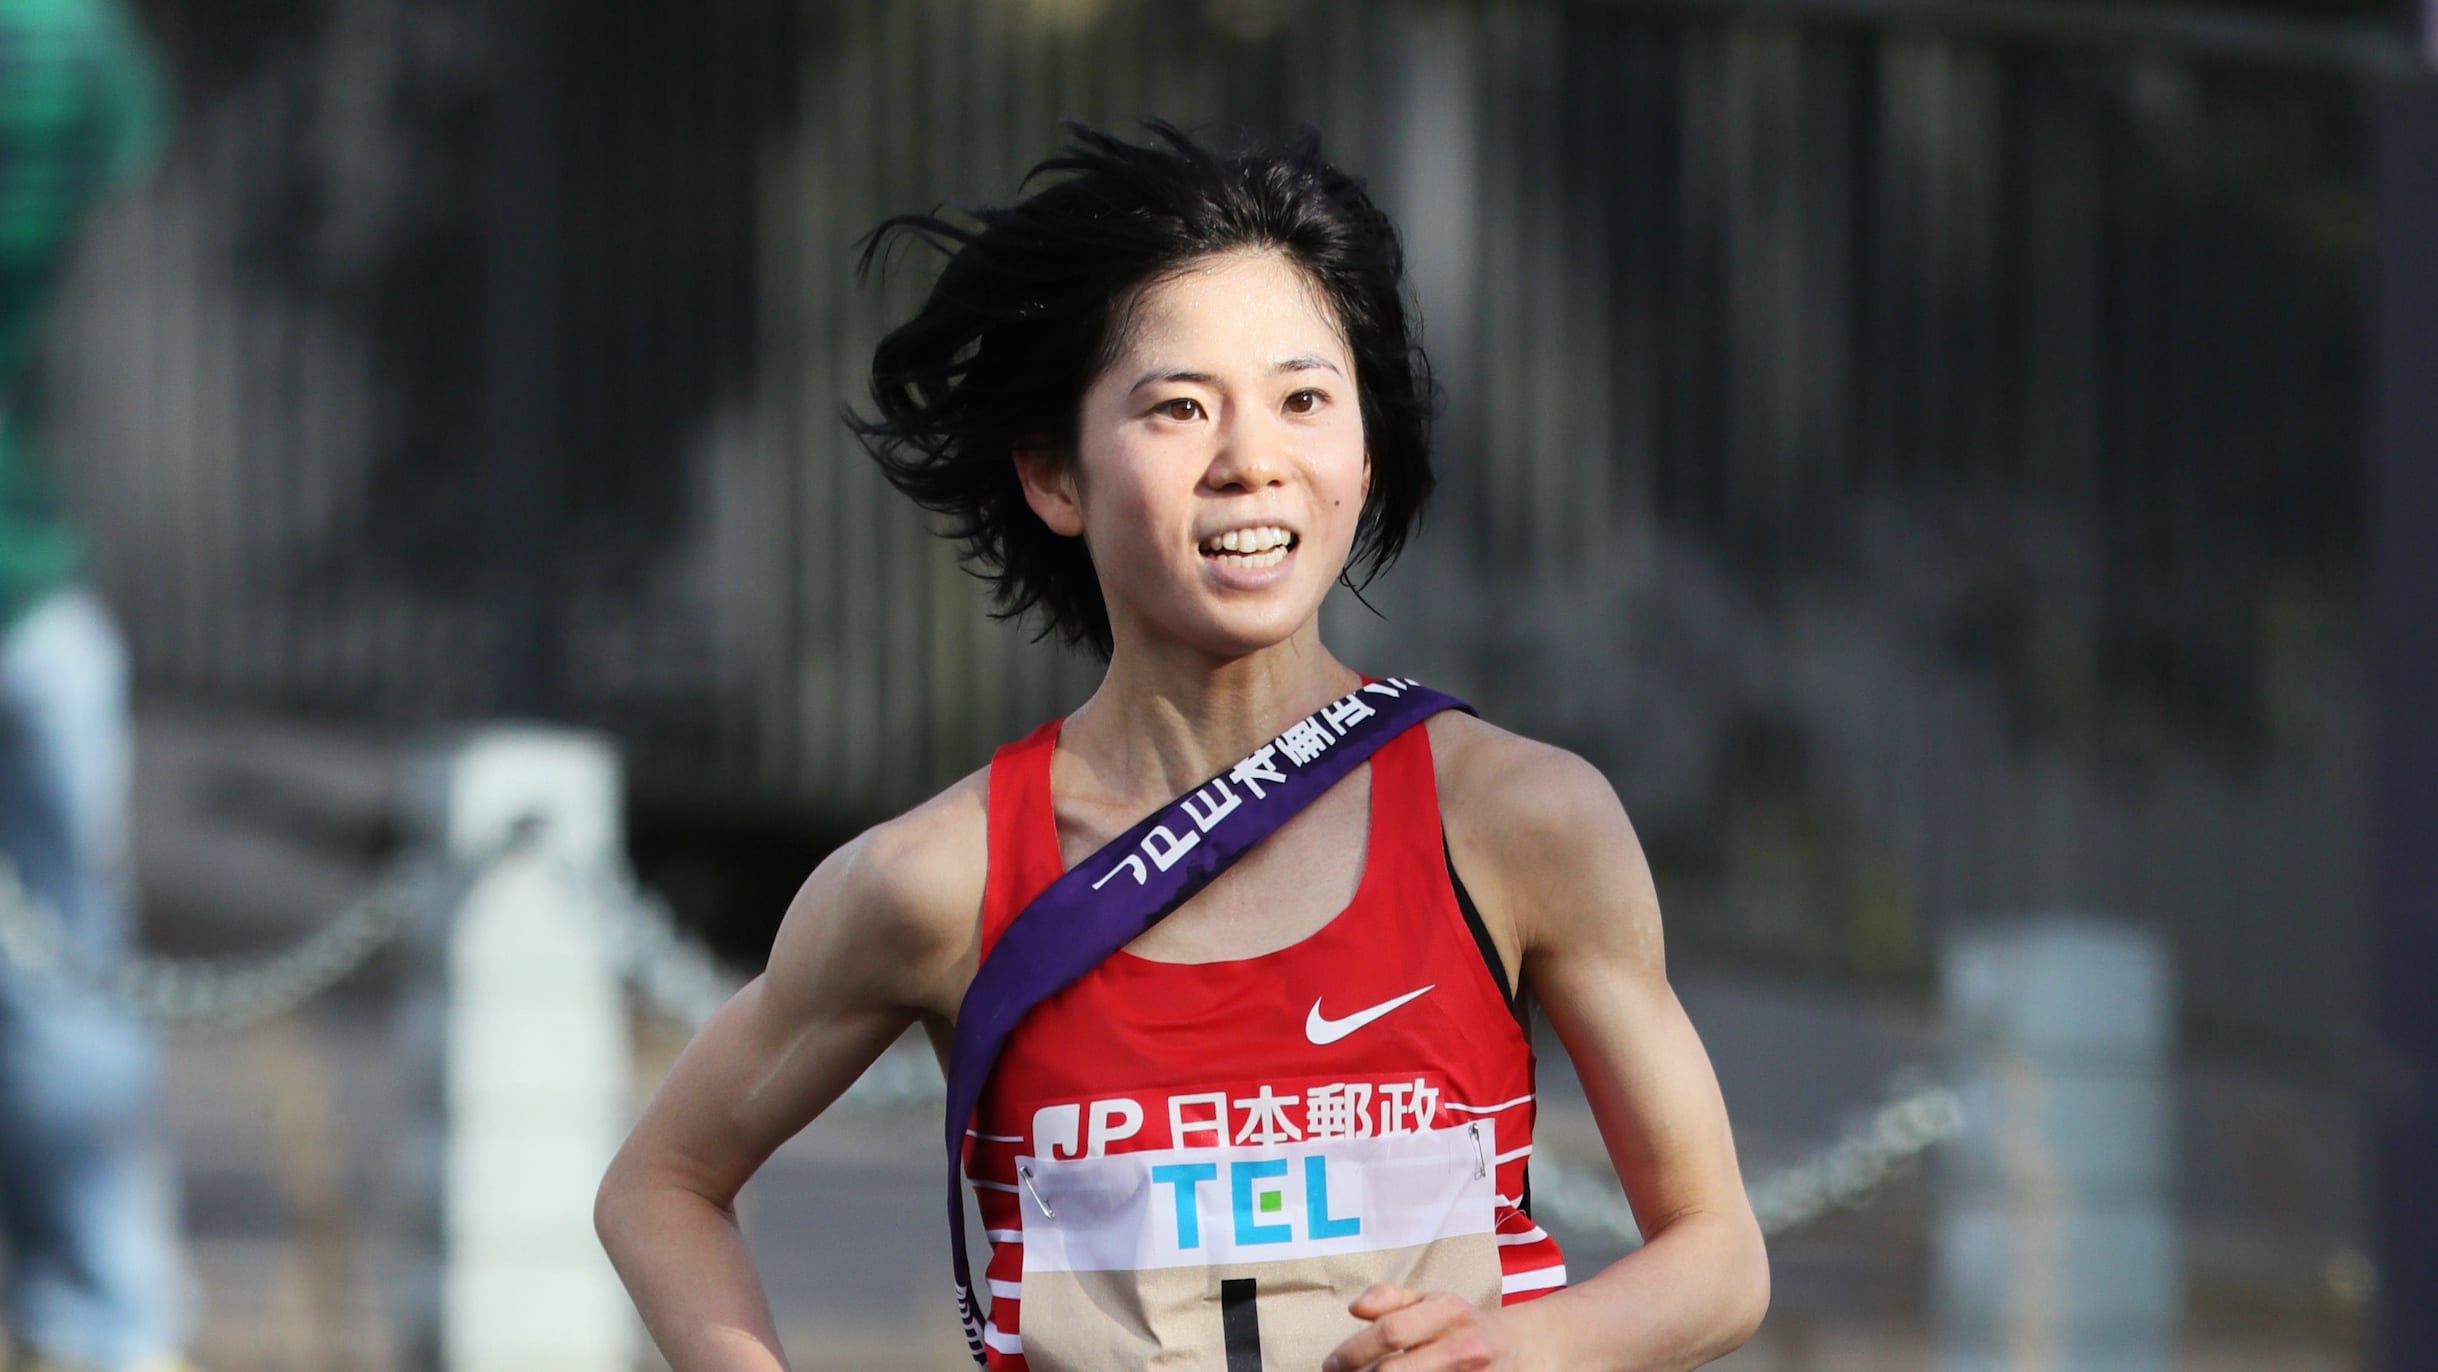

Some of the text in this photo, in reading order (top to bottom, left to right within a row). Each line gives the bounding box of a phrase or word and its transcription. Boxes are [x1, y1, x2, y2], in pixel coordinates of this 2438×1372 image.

[1033, 1078, 1440, 1160] JP 日本郵政
[1151, 1155, 1361, 1250] TEL
